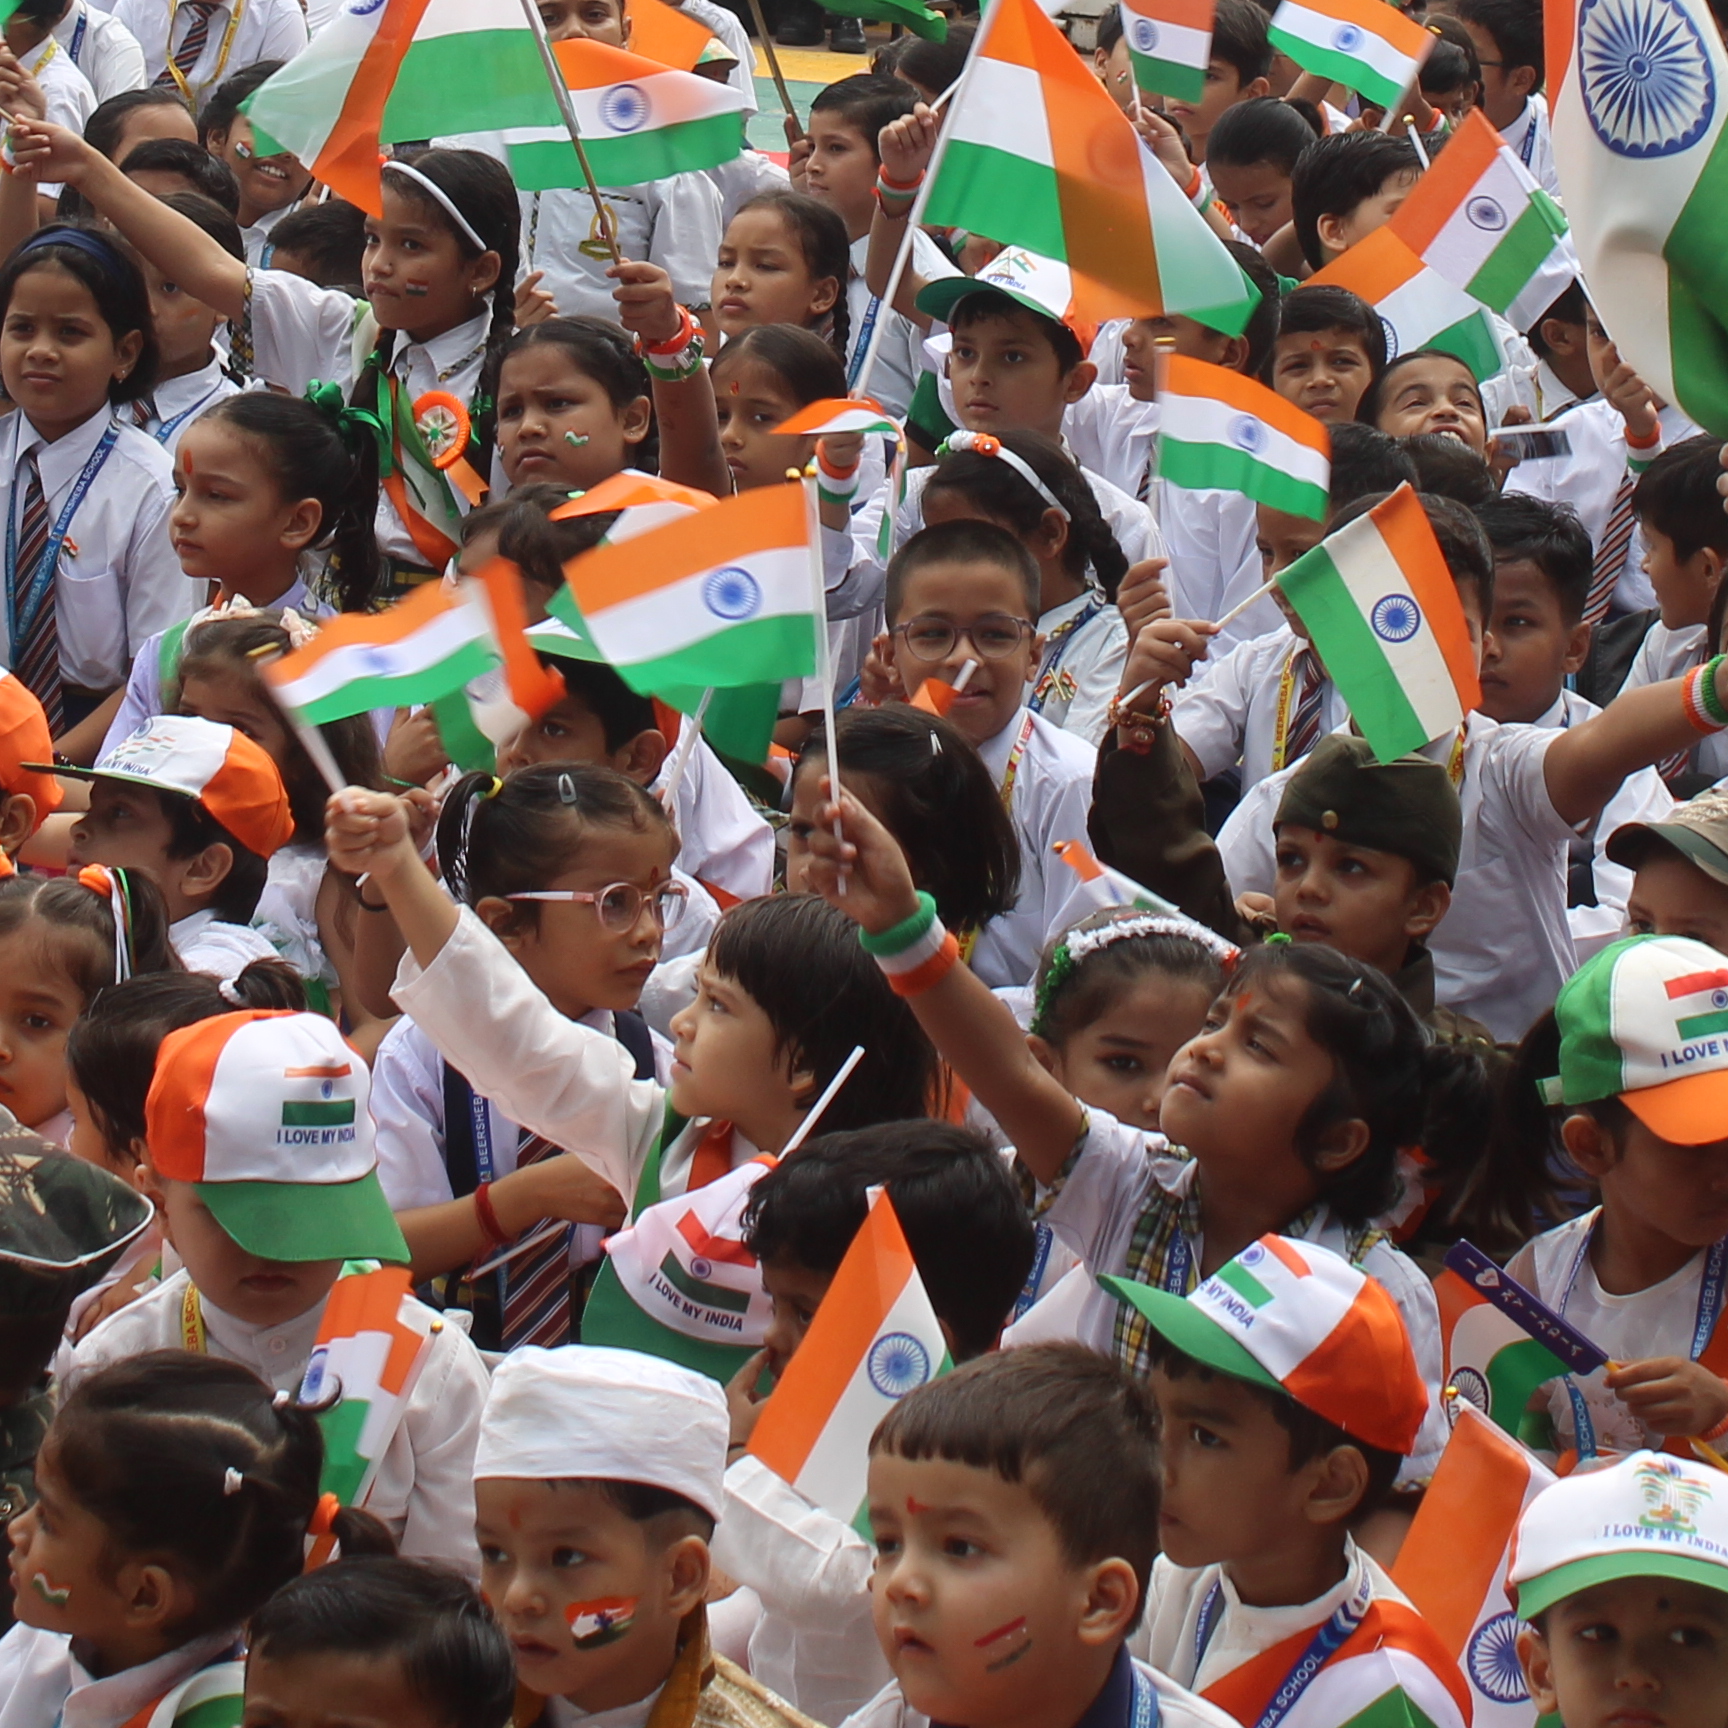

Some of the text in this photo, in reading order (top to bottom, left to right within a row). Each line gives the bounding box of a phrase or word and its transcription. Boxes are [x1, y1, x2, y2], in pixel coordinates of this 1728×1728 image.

[84, 448, 106, 481] SCHOOL
[37, 545, 57, 581] SCHOOL
[1660, 1053, 1668, 1068] I
[1672, 1041, 1719, 1066] LOVE
[277, 1127, 355, 1145] I LOVE MY INDIA
[648, 1273, 744, 1332] I LOVE MY INDIA
[1222, 1297, 1255, 1330] INDIA
[1692, 1279, 1718, 1358] BEERSHEBA
[1531, 1311, 1583, 1357] INDIA
[1575, 1394, 1591, 1450] SCHOOL
[1603, 1525, 1728, 1559] I LOVE MY INDIA
[1276, 1653, 1324, 1708] SCHOOL
